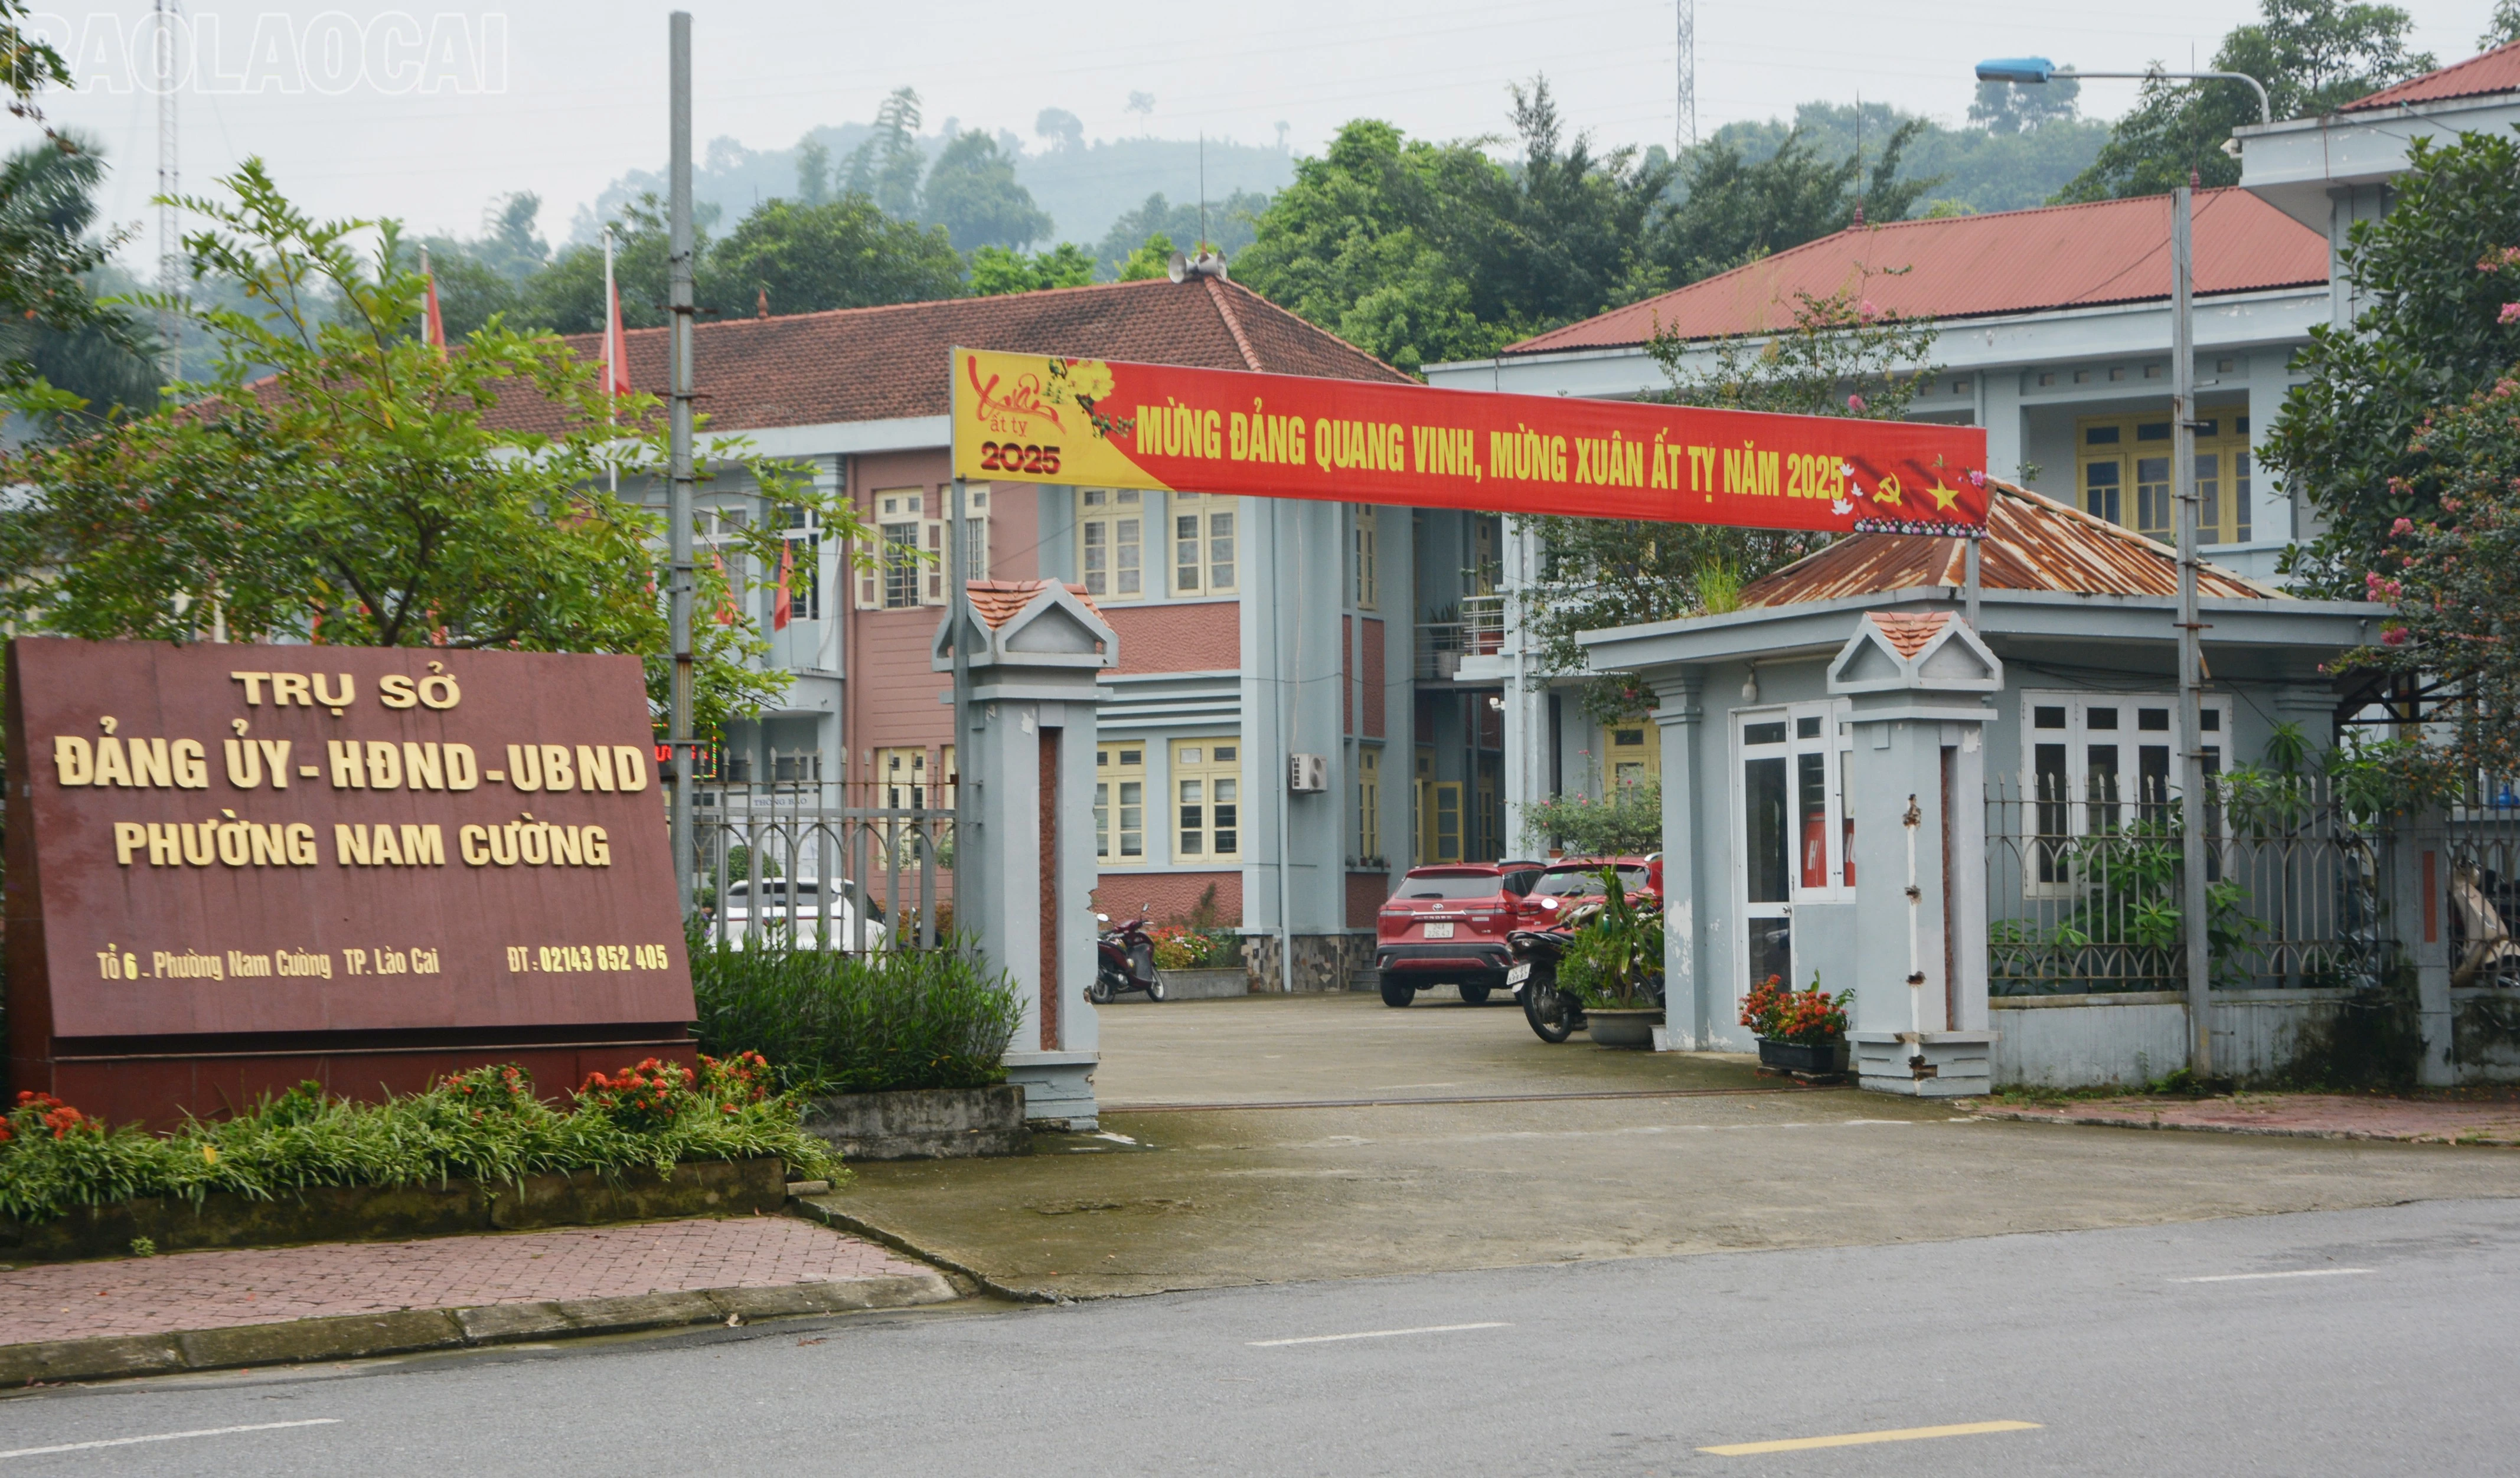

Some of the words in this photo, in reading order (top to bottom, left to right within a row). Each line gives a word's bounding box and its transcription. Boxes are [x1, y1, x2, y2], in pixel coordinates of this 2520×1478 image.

[981, 441, 1061, 475] 2025
[1137, 397, 1221, 459] MỪNG
[1229, 397, 1305, 465] ĐẢNG
[1315, 418, 1404, 472] QUANG
[1412, 426, 1481, 483] VINH,
[1490, 423, 1566, 482] MỪNG
[1575, 430, 1643, 487] XUÂN
[1651, 427, 1681, 489] ẤT
[1688, 446, 1716, 502] TỴ
[1724, 440, 1779, 496] NĂM
[1787, 453, 1844, 501] 2025
[232, 671, 355, 715] TRỤ
[380, 661, 461, 708] SỞ
[55, 716, 208, 787] ĐẢNG
[115, 809, 318, 865] PHƯỜNG
[335, 824, 445, 864] NAM
[460, 812, 611, 865] CƯỜNG
[97, 943, 120, 979] Tổ
[154, 948, 224, 980] Phường
[228, 950, 271, 977] Nam
[276, 947, 332, 979] Cường
[344, 949, 370, 975] TP.
[375, 946, 407, 975] Lào
[411, 947, 439, 973] Cai
[539, 946, 594, 972] 02143
[596, 944, 632, 971] 852
[635, 944, 669, 970] 405
